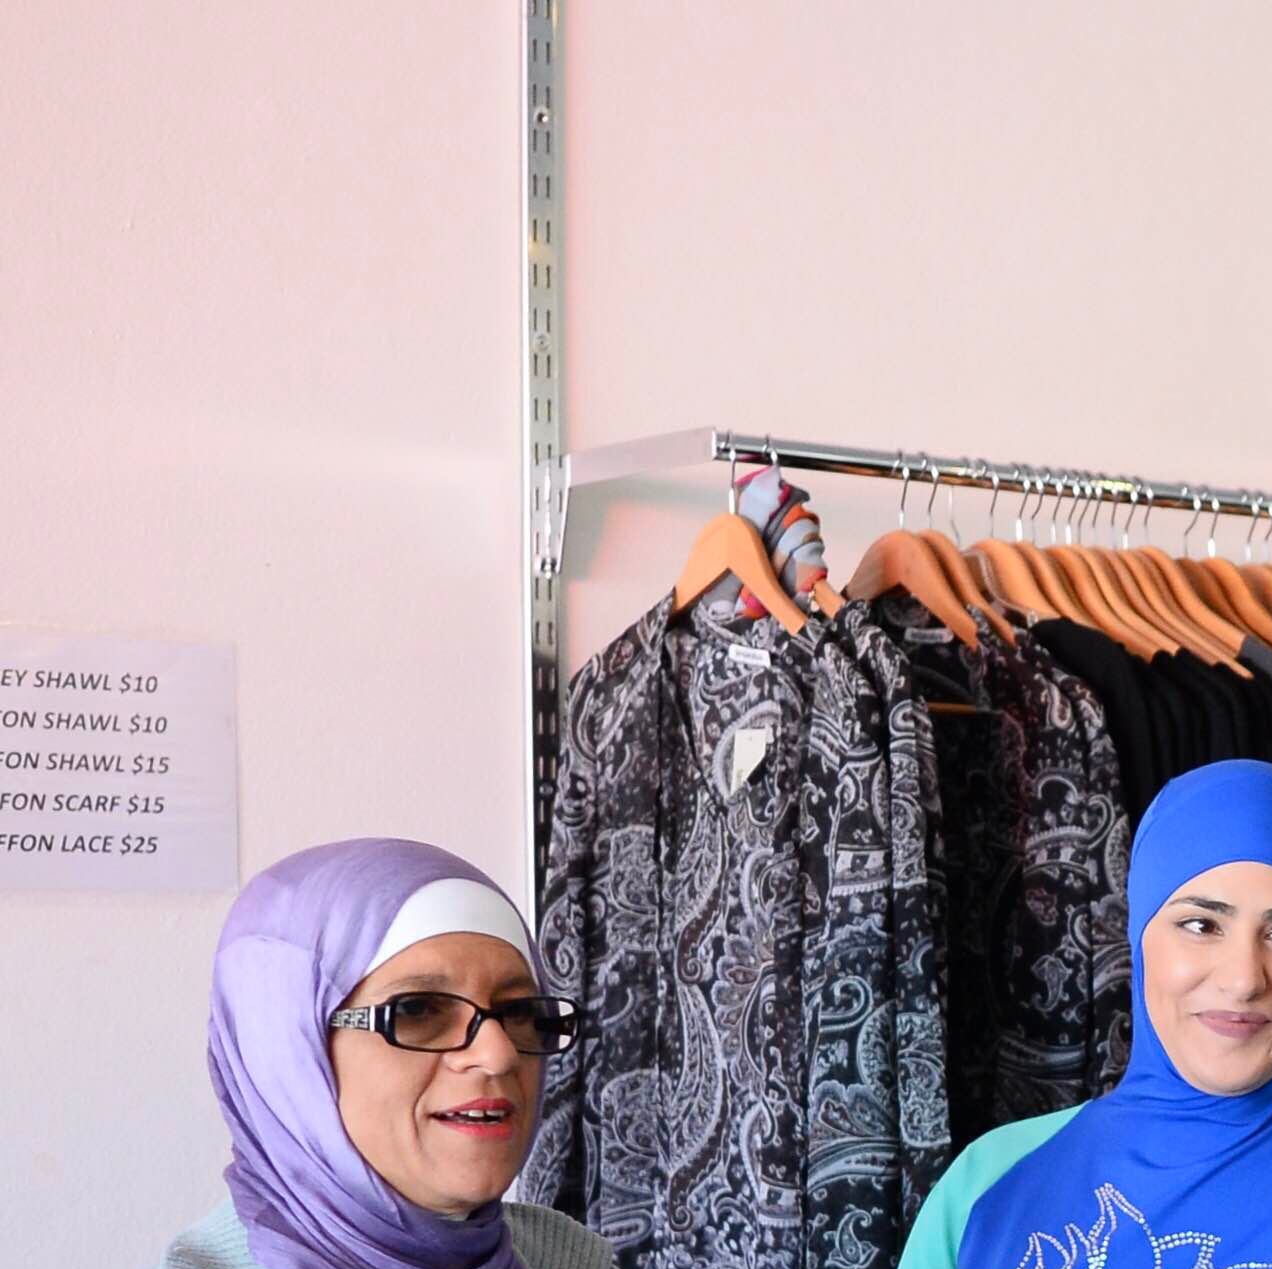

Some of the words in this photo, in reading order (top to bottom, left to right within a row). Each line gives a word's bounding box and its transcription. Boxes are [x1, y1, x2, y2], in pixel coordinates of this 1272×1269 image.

[33, 670, 112, 691] SHAWL
[119, 673, 158, 694] $10
[0, 710, 37, 729] ON
[42, 711, 122, 732] SHAWL
[129, 714, 168, 735] $10
[46, 752, 125, 773] SHAWL
[132, 754, 170, 775] $15
[52, 793, 121, 813] SCARF
[127, 795, 165, 815] $15
[61, 835, 114, 853] LACE
[120, 833, 158, 855] $25
